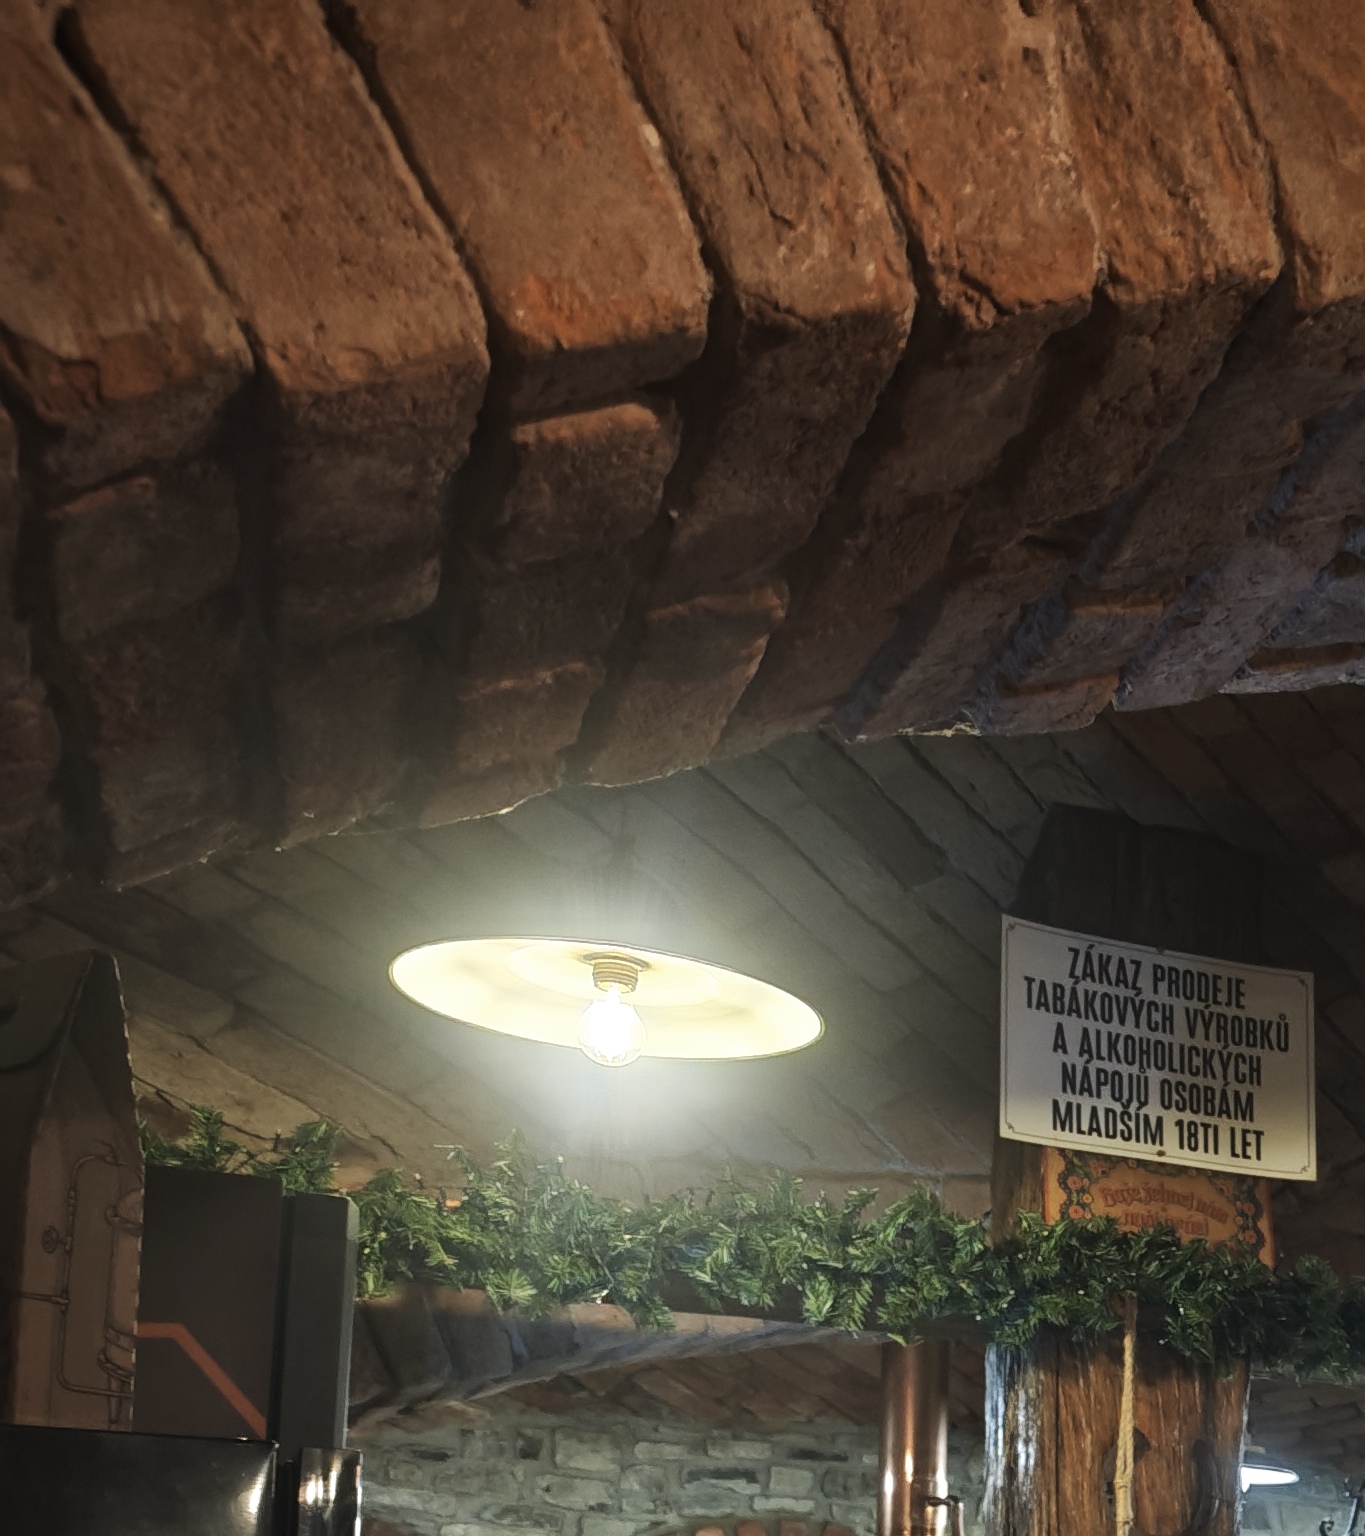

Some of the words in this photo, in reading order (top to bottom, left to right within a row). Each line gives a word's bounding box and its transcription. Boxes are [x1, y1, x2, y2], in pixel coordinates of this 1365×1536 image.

[1067, 944, 1143, 995] ZÁKAZ
[1151, 963, 1246, 1010] PRODEJE
[1023, 975, 1175, 1036] TABÁKOVÝCH
[1184, 1003, 1290, 1053] VÝROBKŮ
[1052, 1022, 1068, 1055] A
[1078, 1026, 1262, 1087] ALKOHOLICKÝCH
[1061, 1058, 1150, 1109] NÁPOJŮ
[1159, 1077, 1256, 1123] OSOBÁM
[1051, 1098, 1165, 1147] MLADŠÍM
[1174, 1118, 1219, 1155] 18TI
[1229, 1127, 1265, 1162] LET
